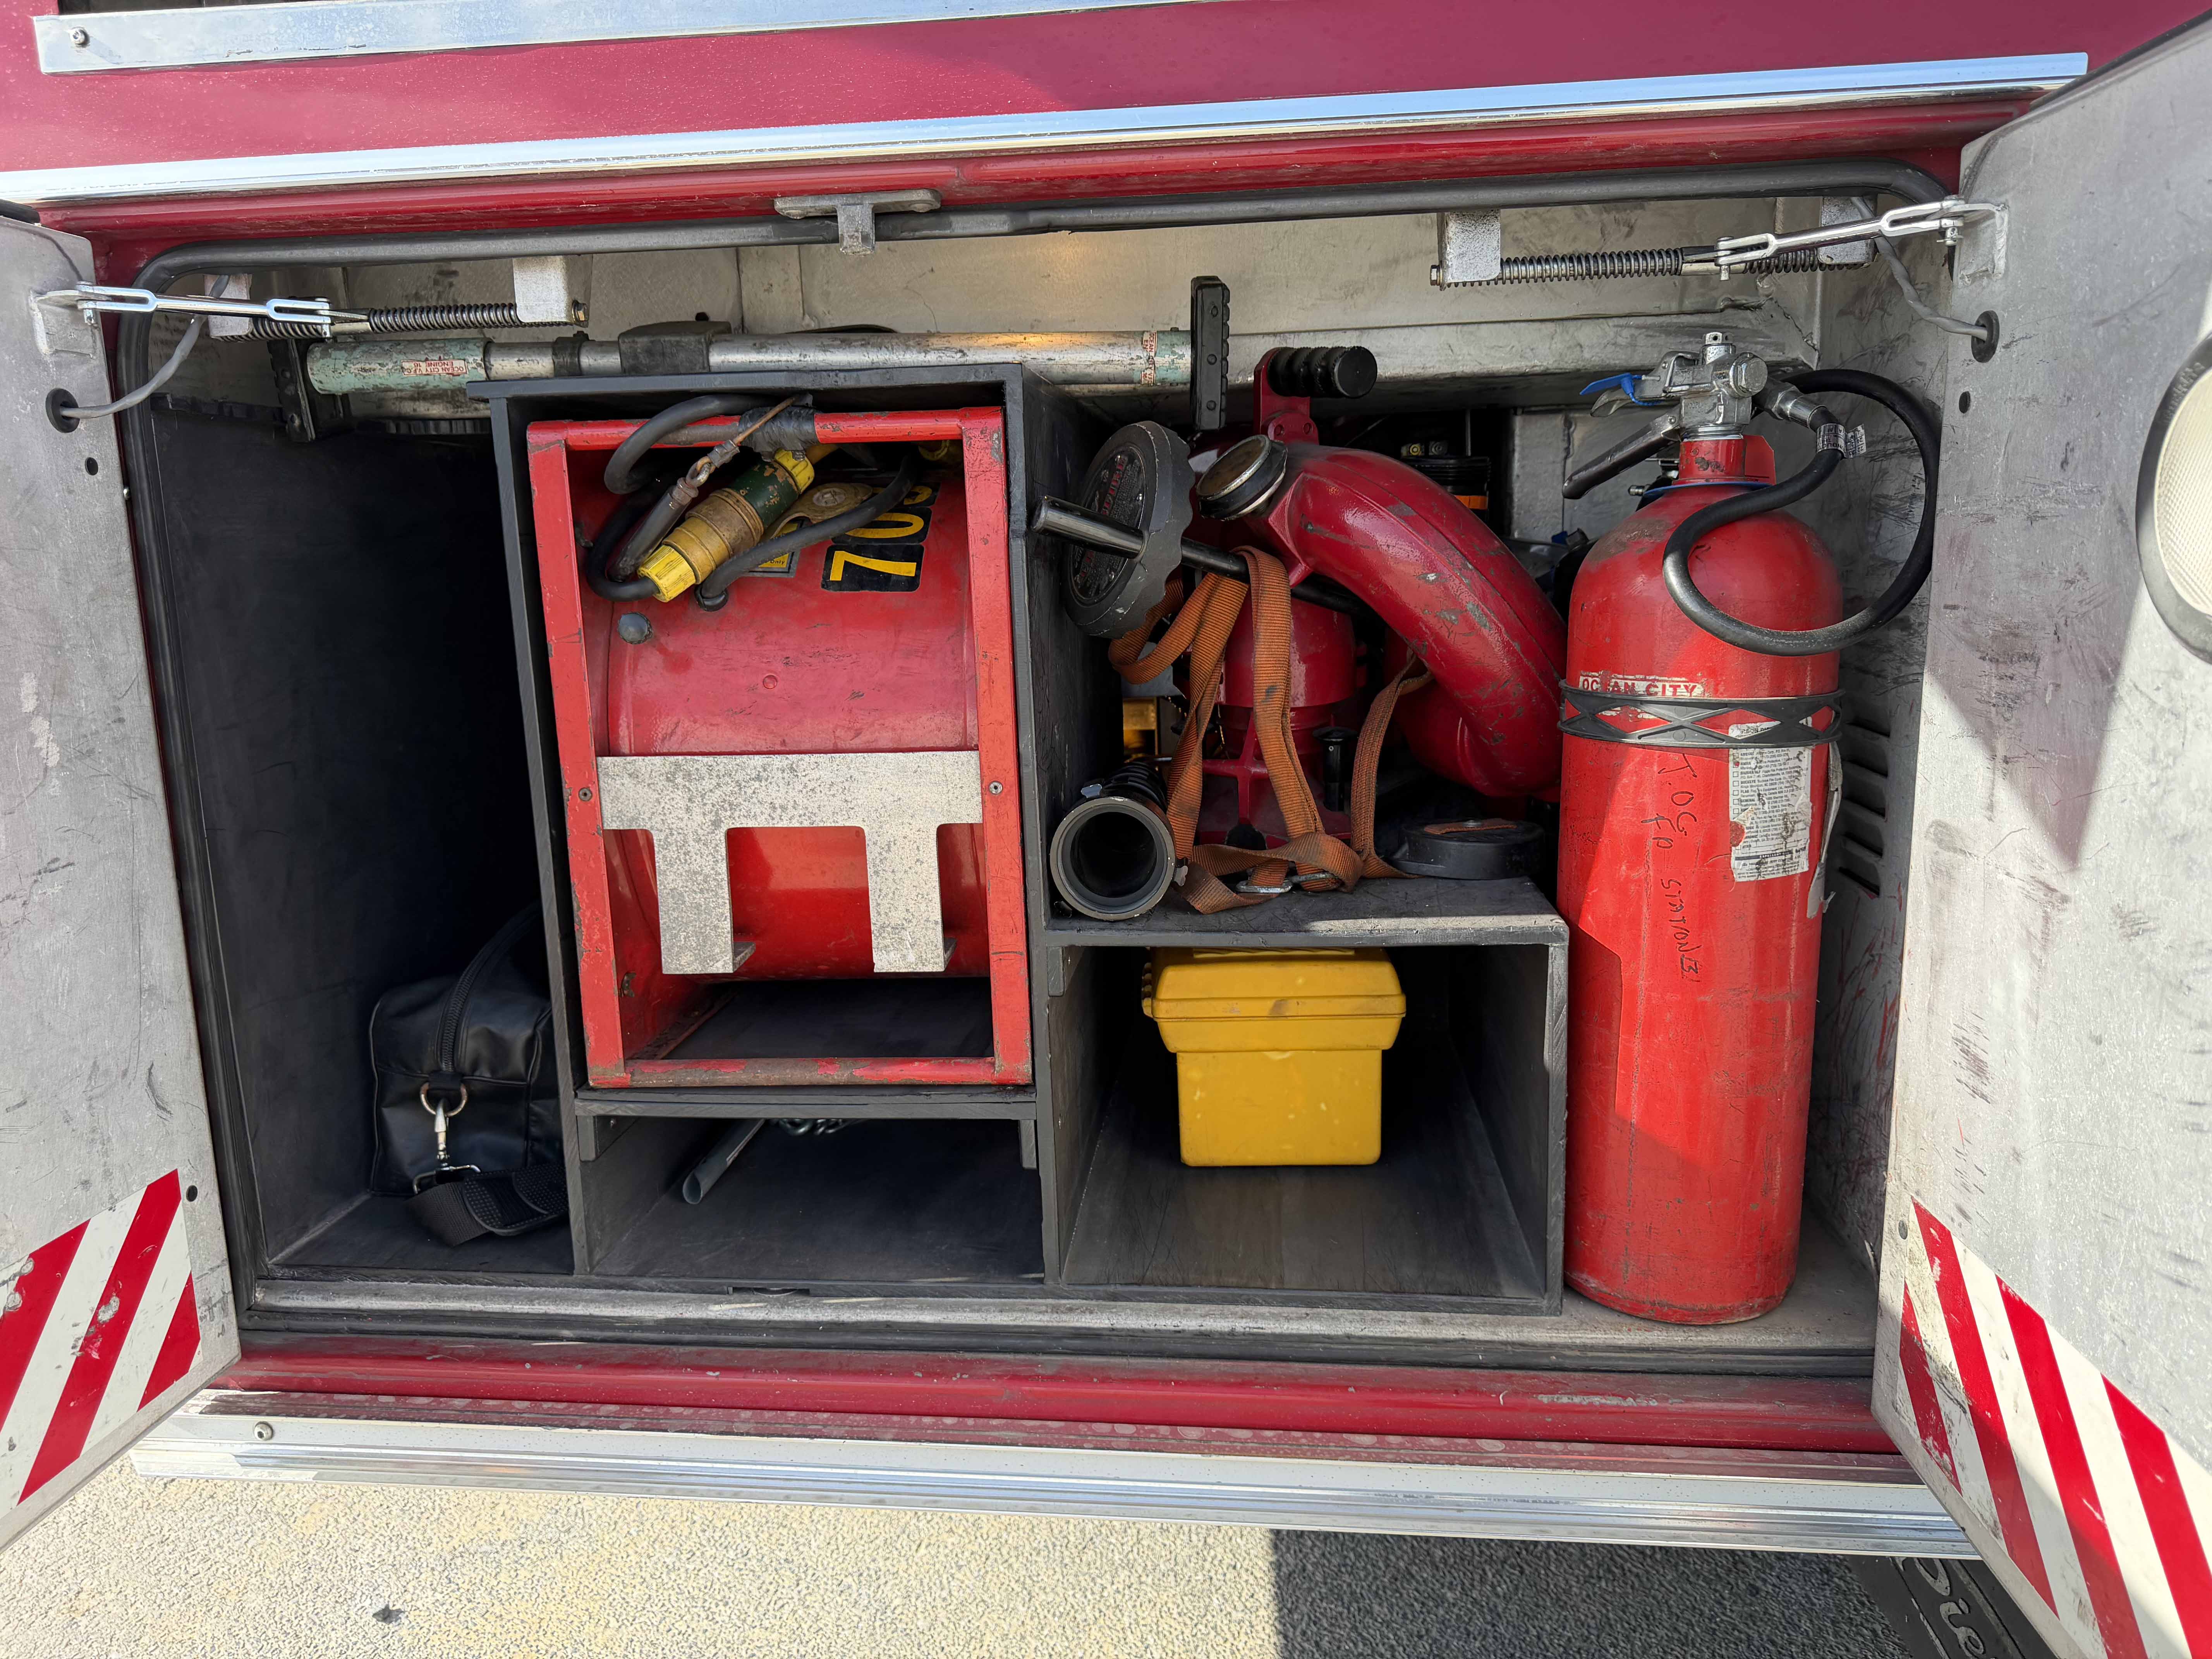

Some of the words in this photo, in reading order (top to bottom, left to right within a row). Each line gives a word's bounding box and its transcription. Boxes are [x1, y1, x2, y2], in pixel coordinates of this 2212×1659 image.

[1582, 678, 1636, 694] OCAN
[1645, 682, 1697, 697] CITY
[1660, 878, 1703, 953] STATION
